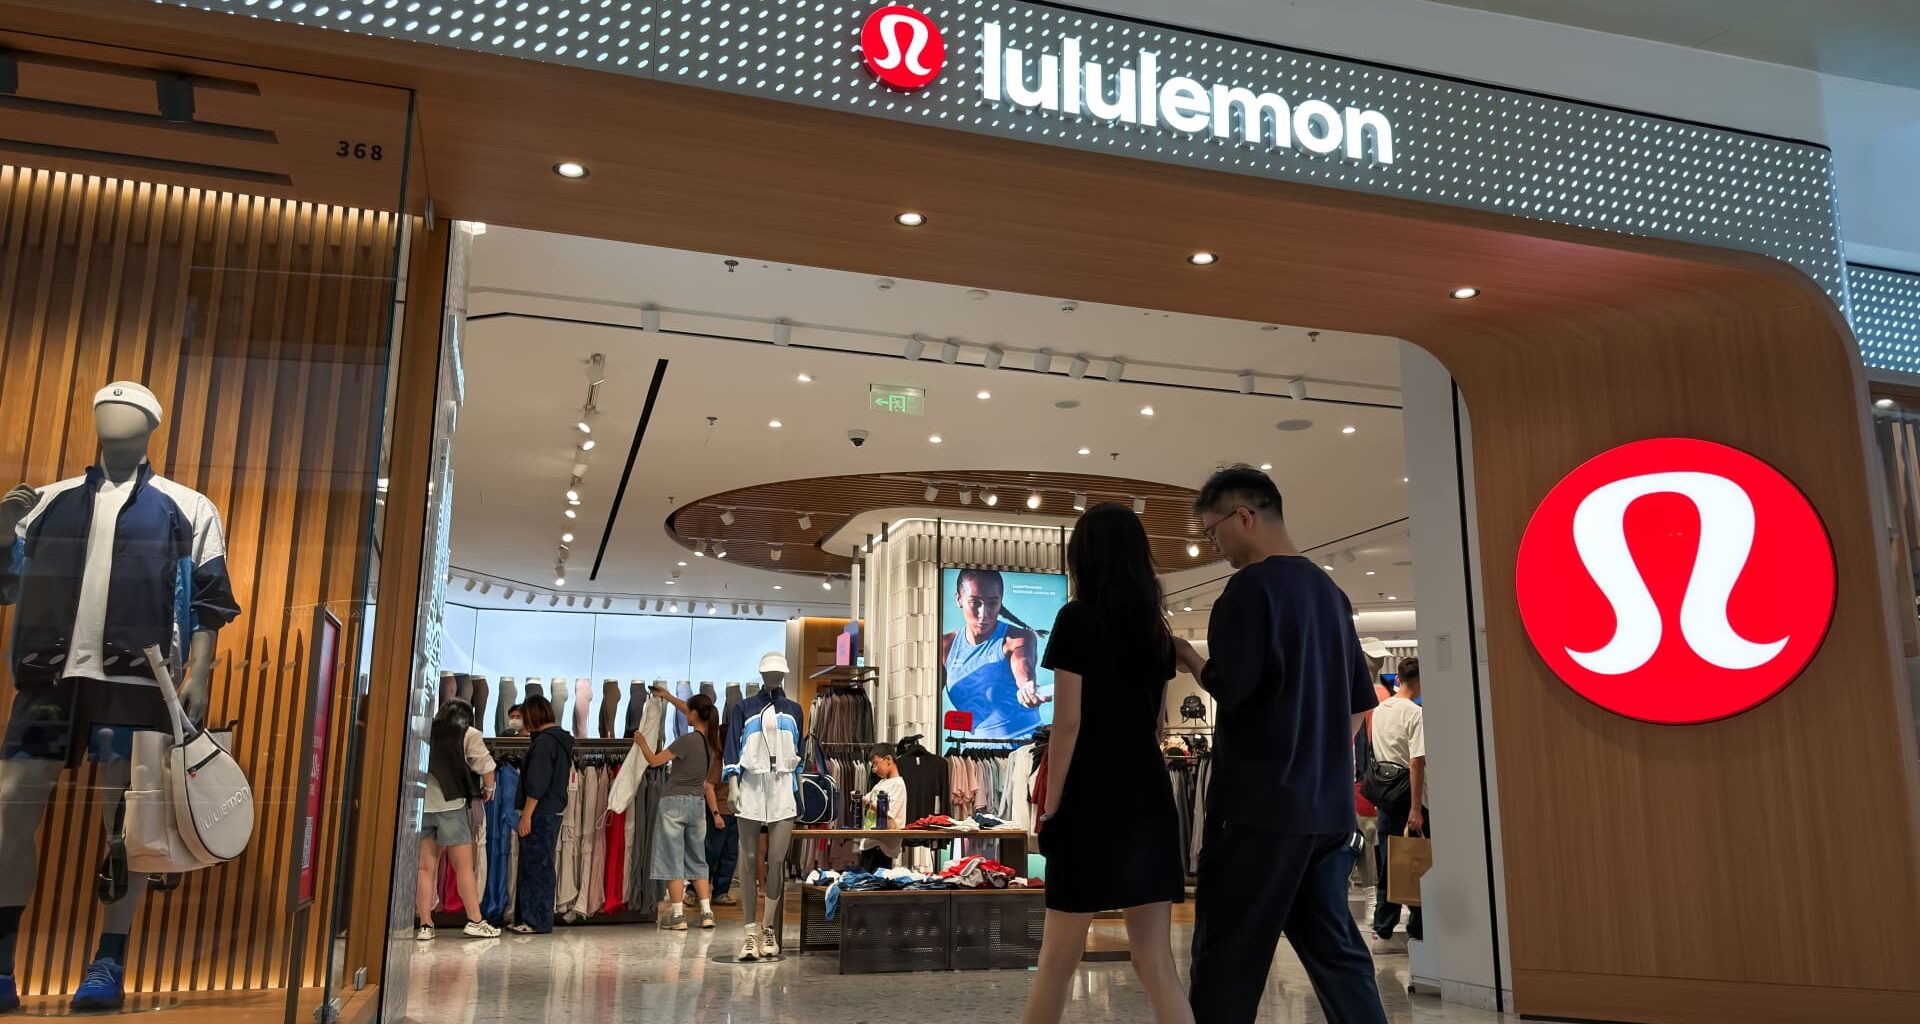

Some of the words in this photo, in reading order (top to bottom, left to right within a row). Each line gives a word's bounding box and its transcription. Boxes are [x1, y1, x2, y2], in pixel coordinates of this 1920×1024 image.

[982, 22, 1393, 164] lululemon
[336, 140, 383, 161] 368
[199, 786, 249, 831] lululemon
